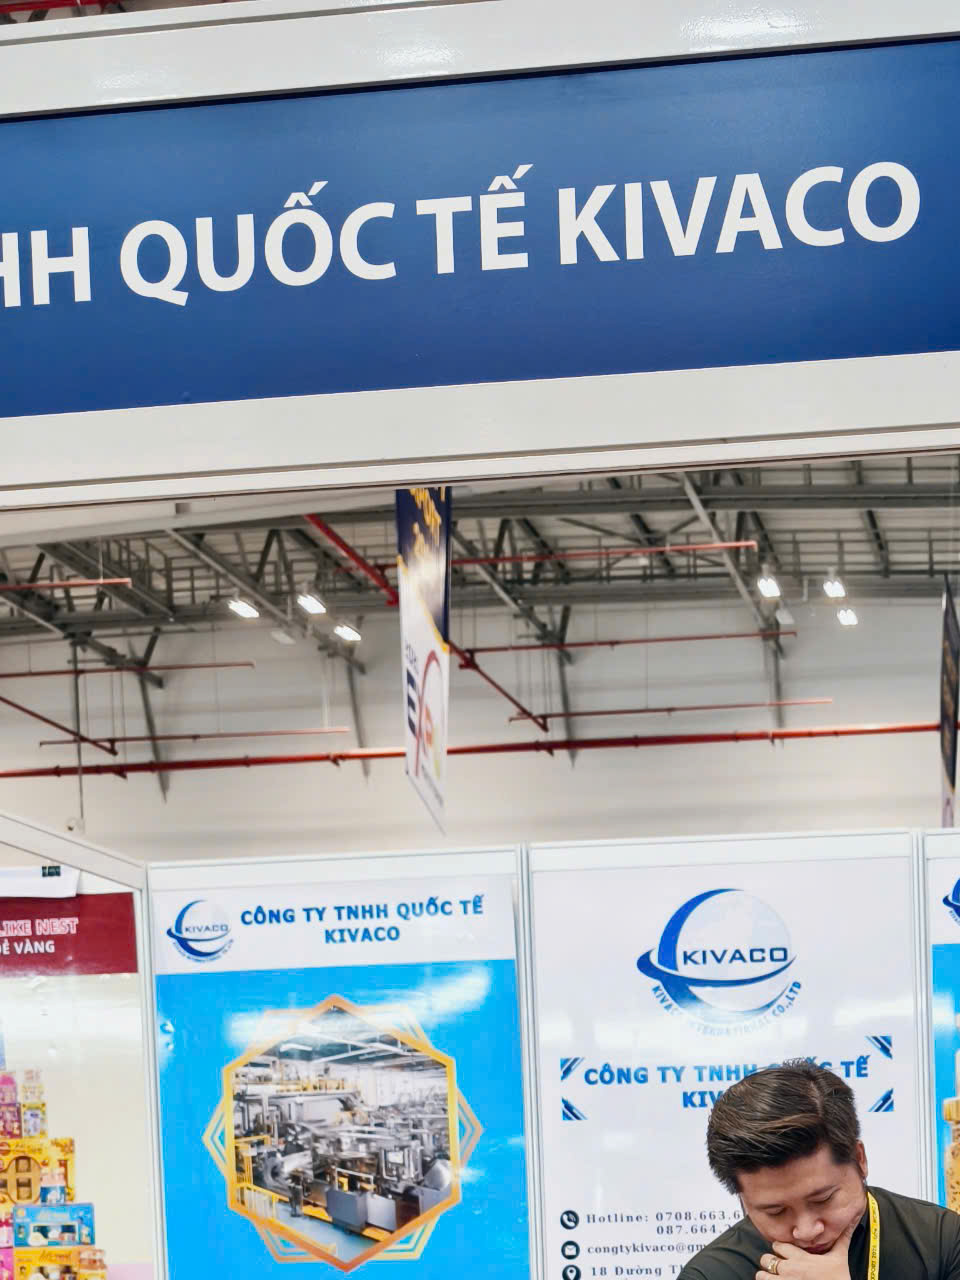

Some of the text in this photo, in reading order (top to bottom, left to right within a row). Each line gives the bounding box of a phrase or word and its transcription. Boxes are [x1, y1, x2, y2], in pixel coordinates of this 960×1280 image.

[0, 161, 921, 308] H QUỐC TẾ KIVACO
[240, 894, 484, 925] CÔNG TY TNHH QUỐC TẾ
[36, 917, 79, 936] NEST
[184, 924, 229, 934] KIVACO
[324, 926, 400, 944] KIVACO
[14, 938, 55, 954] VÀNG
[683, 947, 788, 965] KIVACO
[584, 1063, 649, 1085] CÔNG
[657, 1066, 685, 1083] TY
[840, 1055, 871, 1079] TẾ
[586, 1210, 741, 1224] Hotline: 0708.663.6
[587, 1243, 706, 1256] congtykivaco@gm
[591, 1266, 607, 1276] 18
